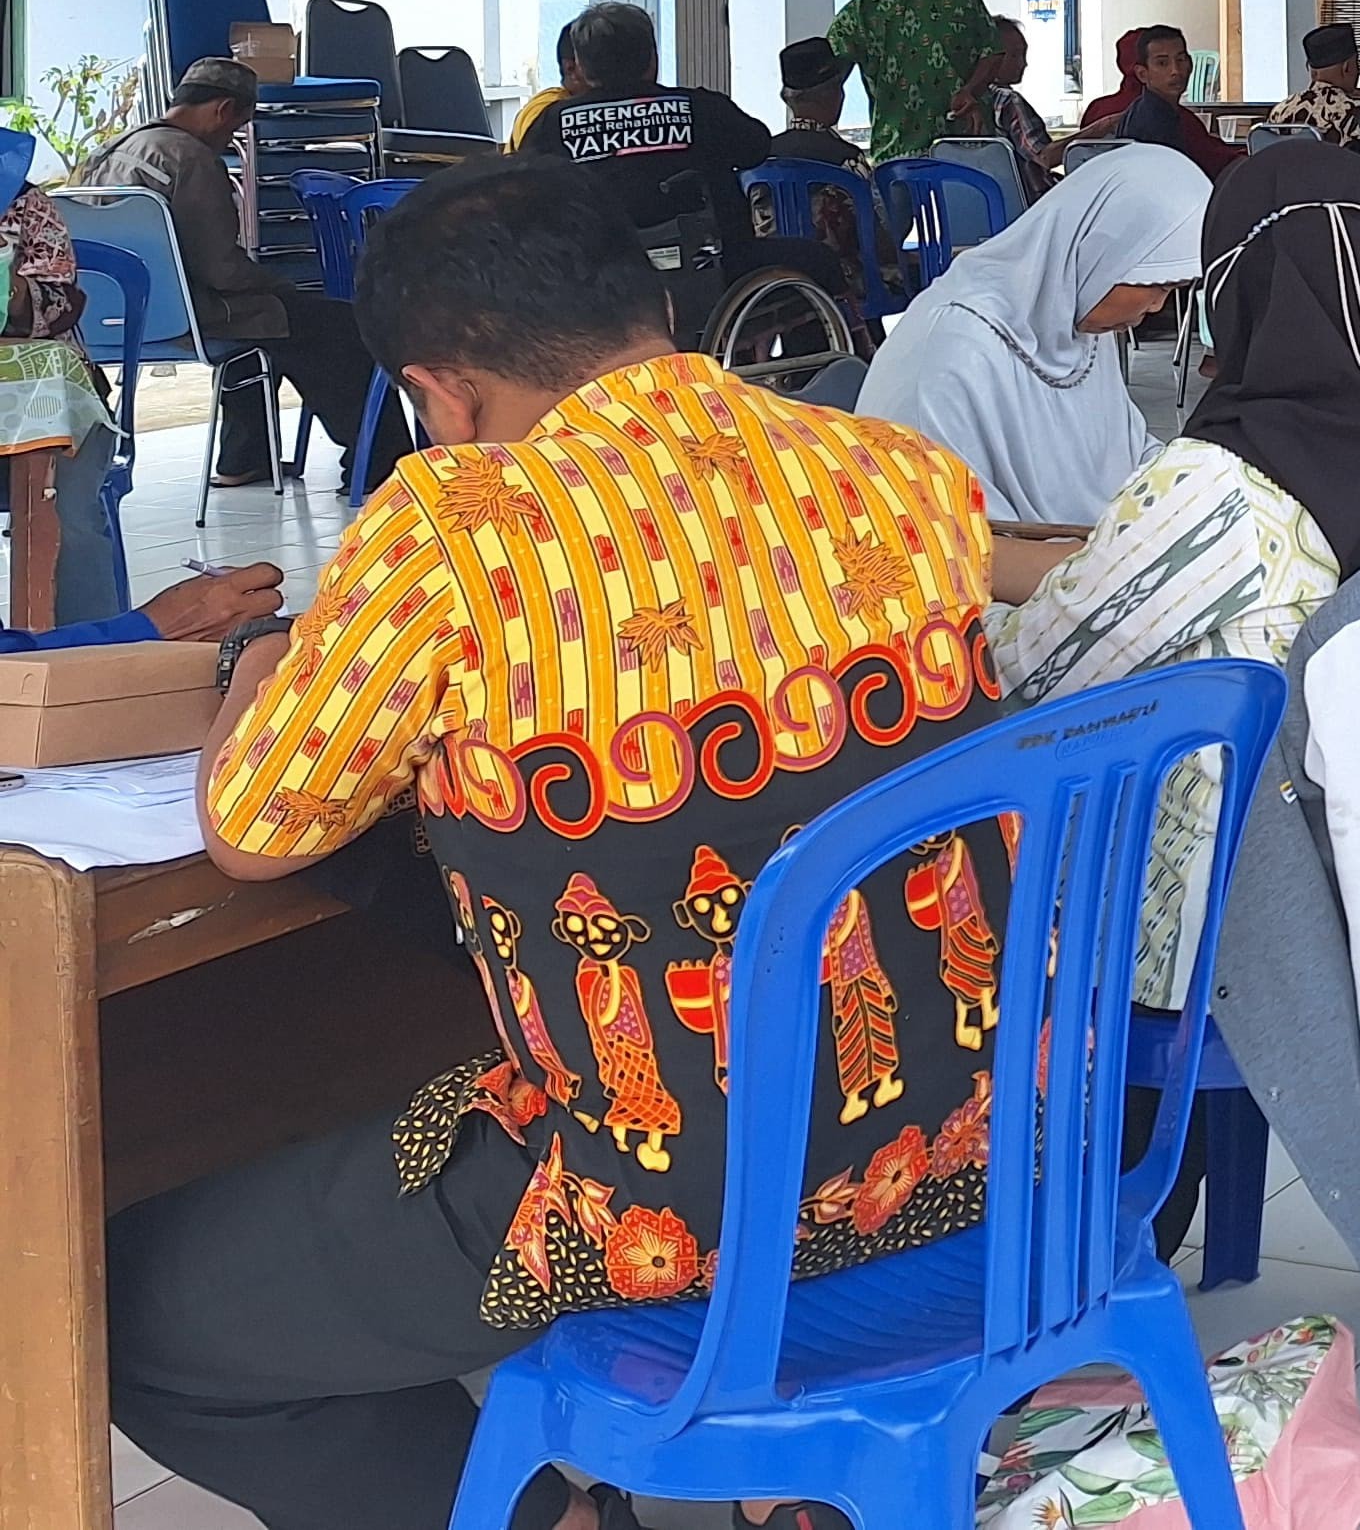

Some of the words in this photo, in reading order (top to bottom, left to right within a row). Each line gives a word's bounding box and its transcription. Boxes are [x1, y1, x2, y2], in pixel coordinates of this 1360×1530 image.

[561, 101, 691, 128] DEKENGANE
[562, 124, 600, 139] Pusat
[605, 115, 692, 130] Rehabilitasi
[564, 125, 692, 158] YAKKUM
